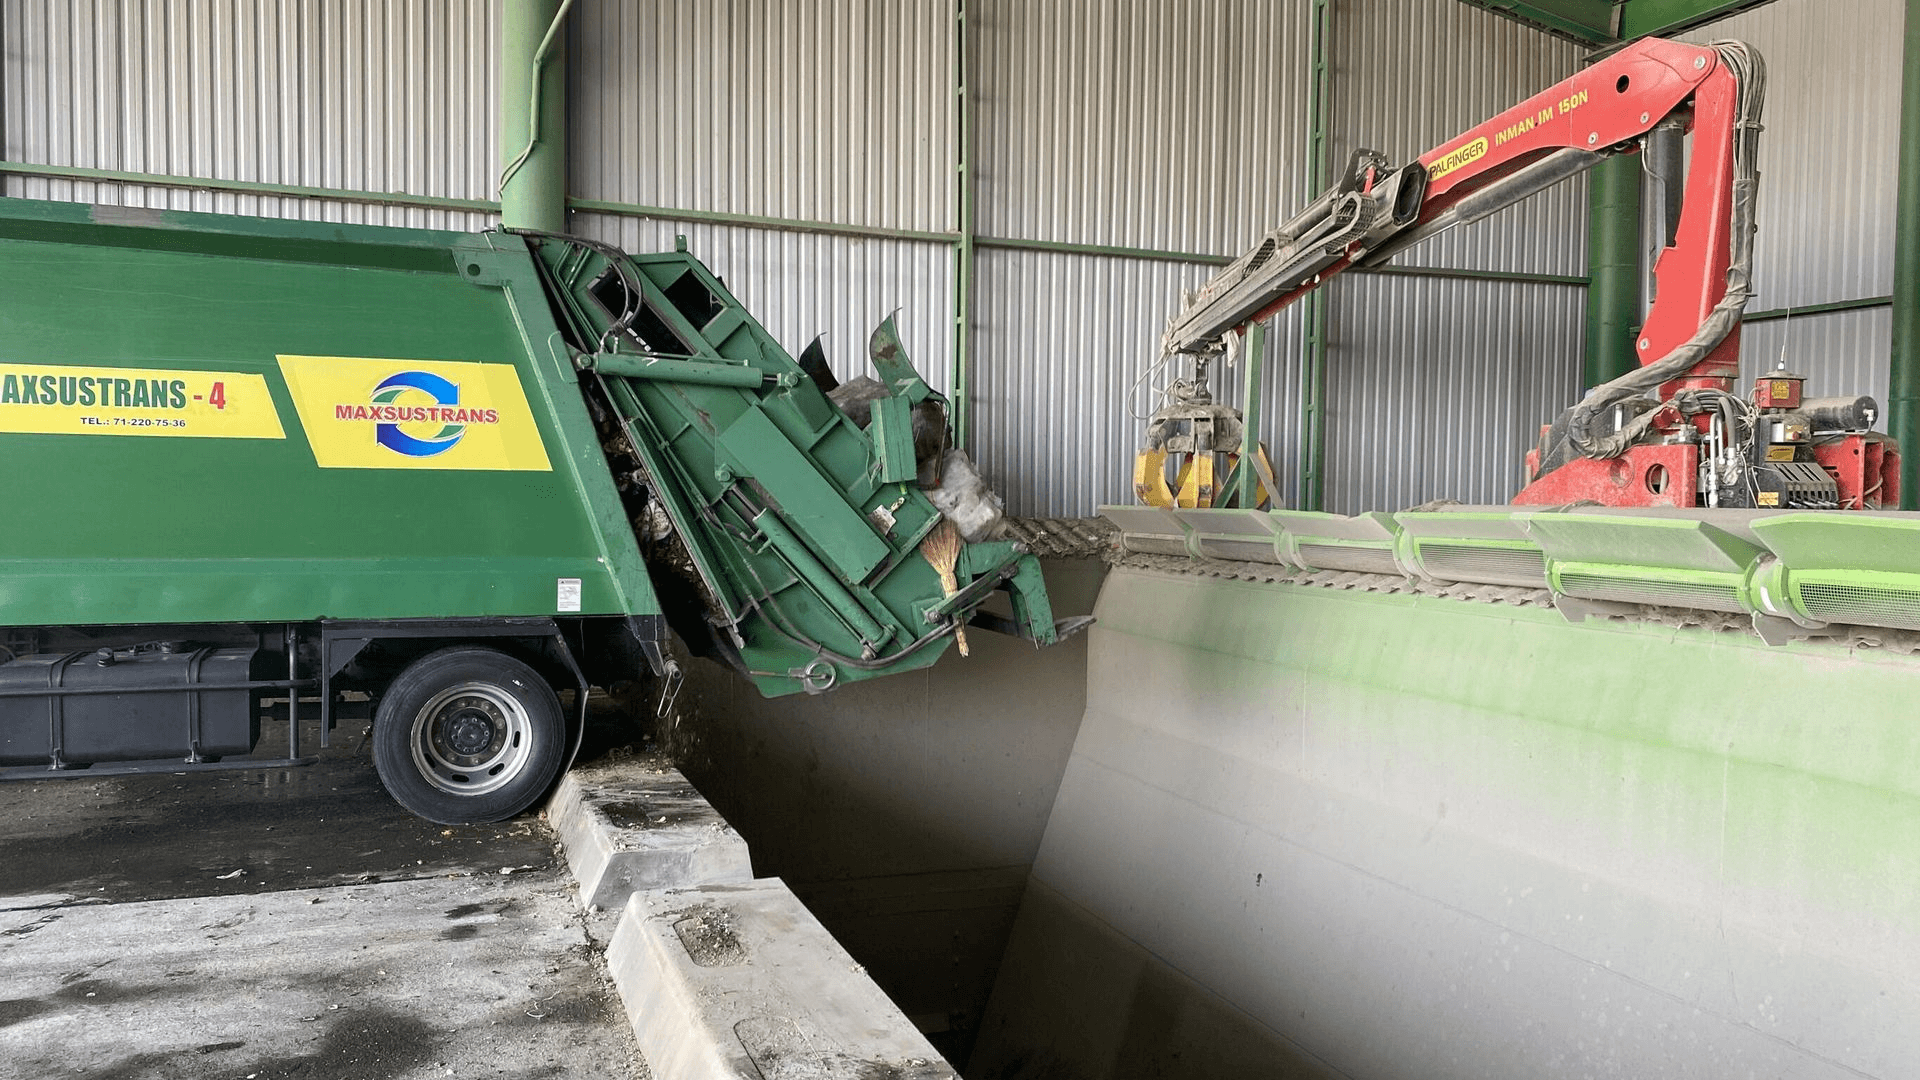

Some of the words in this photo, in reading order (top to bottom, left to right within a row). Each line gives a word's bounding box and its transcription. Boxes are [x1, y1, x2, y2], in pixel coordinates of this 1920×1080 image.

[1496, 117, 1536, 145] INMAN
[1538, 107, 1553, 125] IM
[1558, 90, 1588, 114] 150N
[1429, 141, 1484, 179] PALFINGER
[80, 417, 110, 426] TEL.:
[113, 418, 186, 427] 71-220-75-36
[335, 405, 498, 423] MAXSUSTRANS
